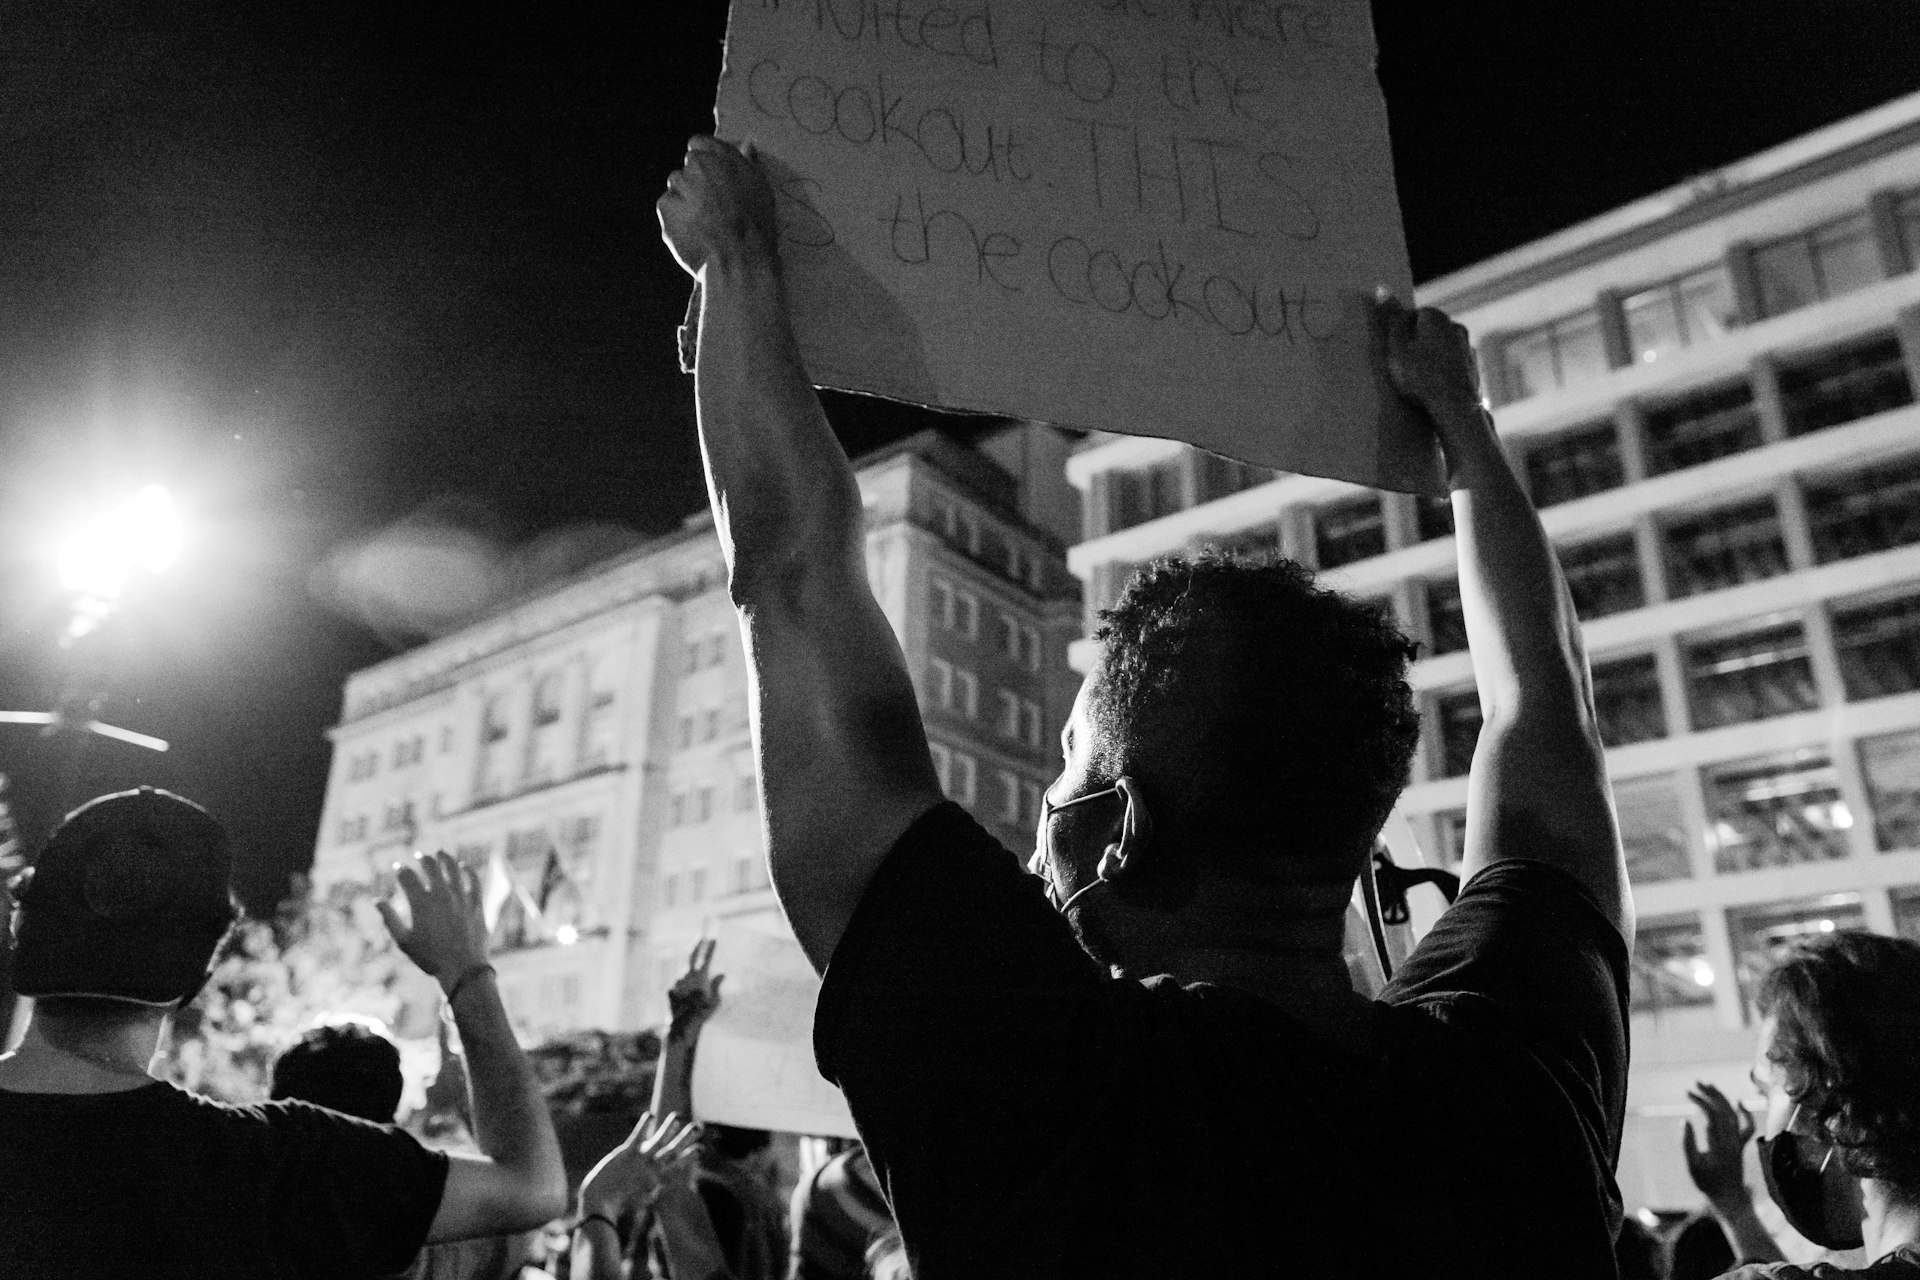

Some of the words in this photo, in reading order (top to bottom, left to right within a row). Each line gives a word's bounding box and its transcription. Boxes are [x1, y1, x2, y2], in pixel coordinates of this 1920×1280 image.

[1034, 21, 1116, 103] to
[1160, 47, 1278, 124] the
[1063, 116, 1320, 242] THIS
[876, 187, 1021, 292] the
